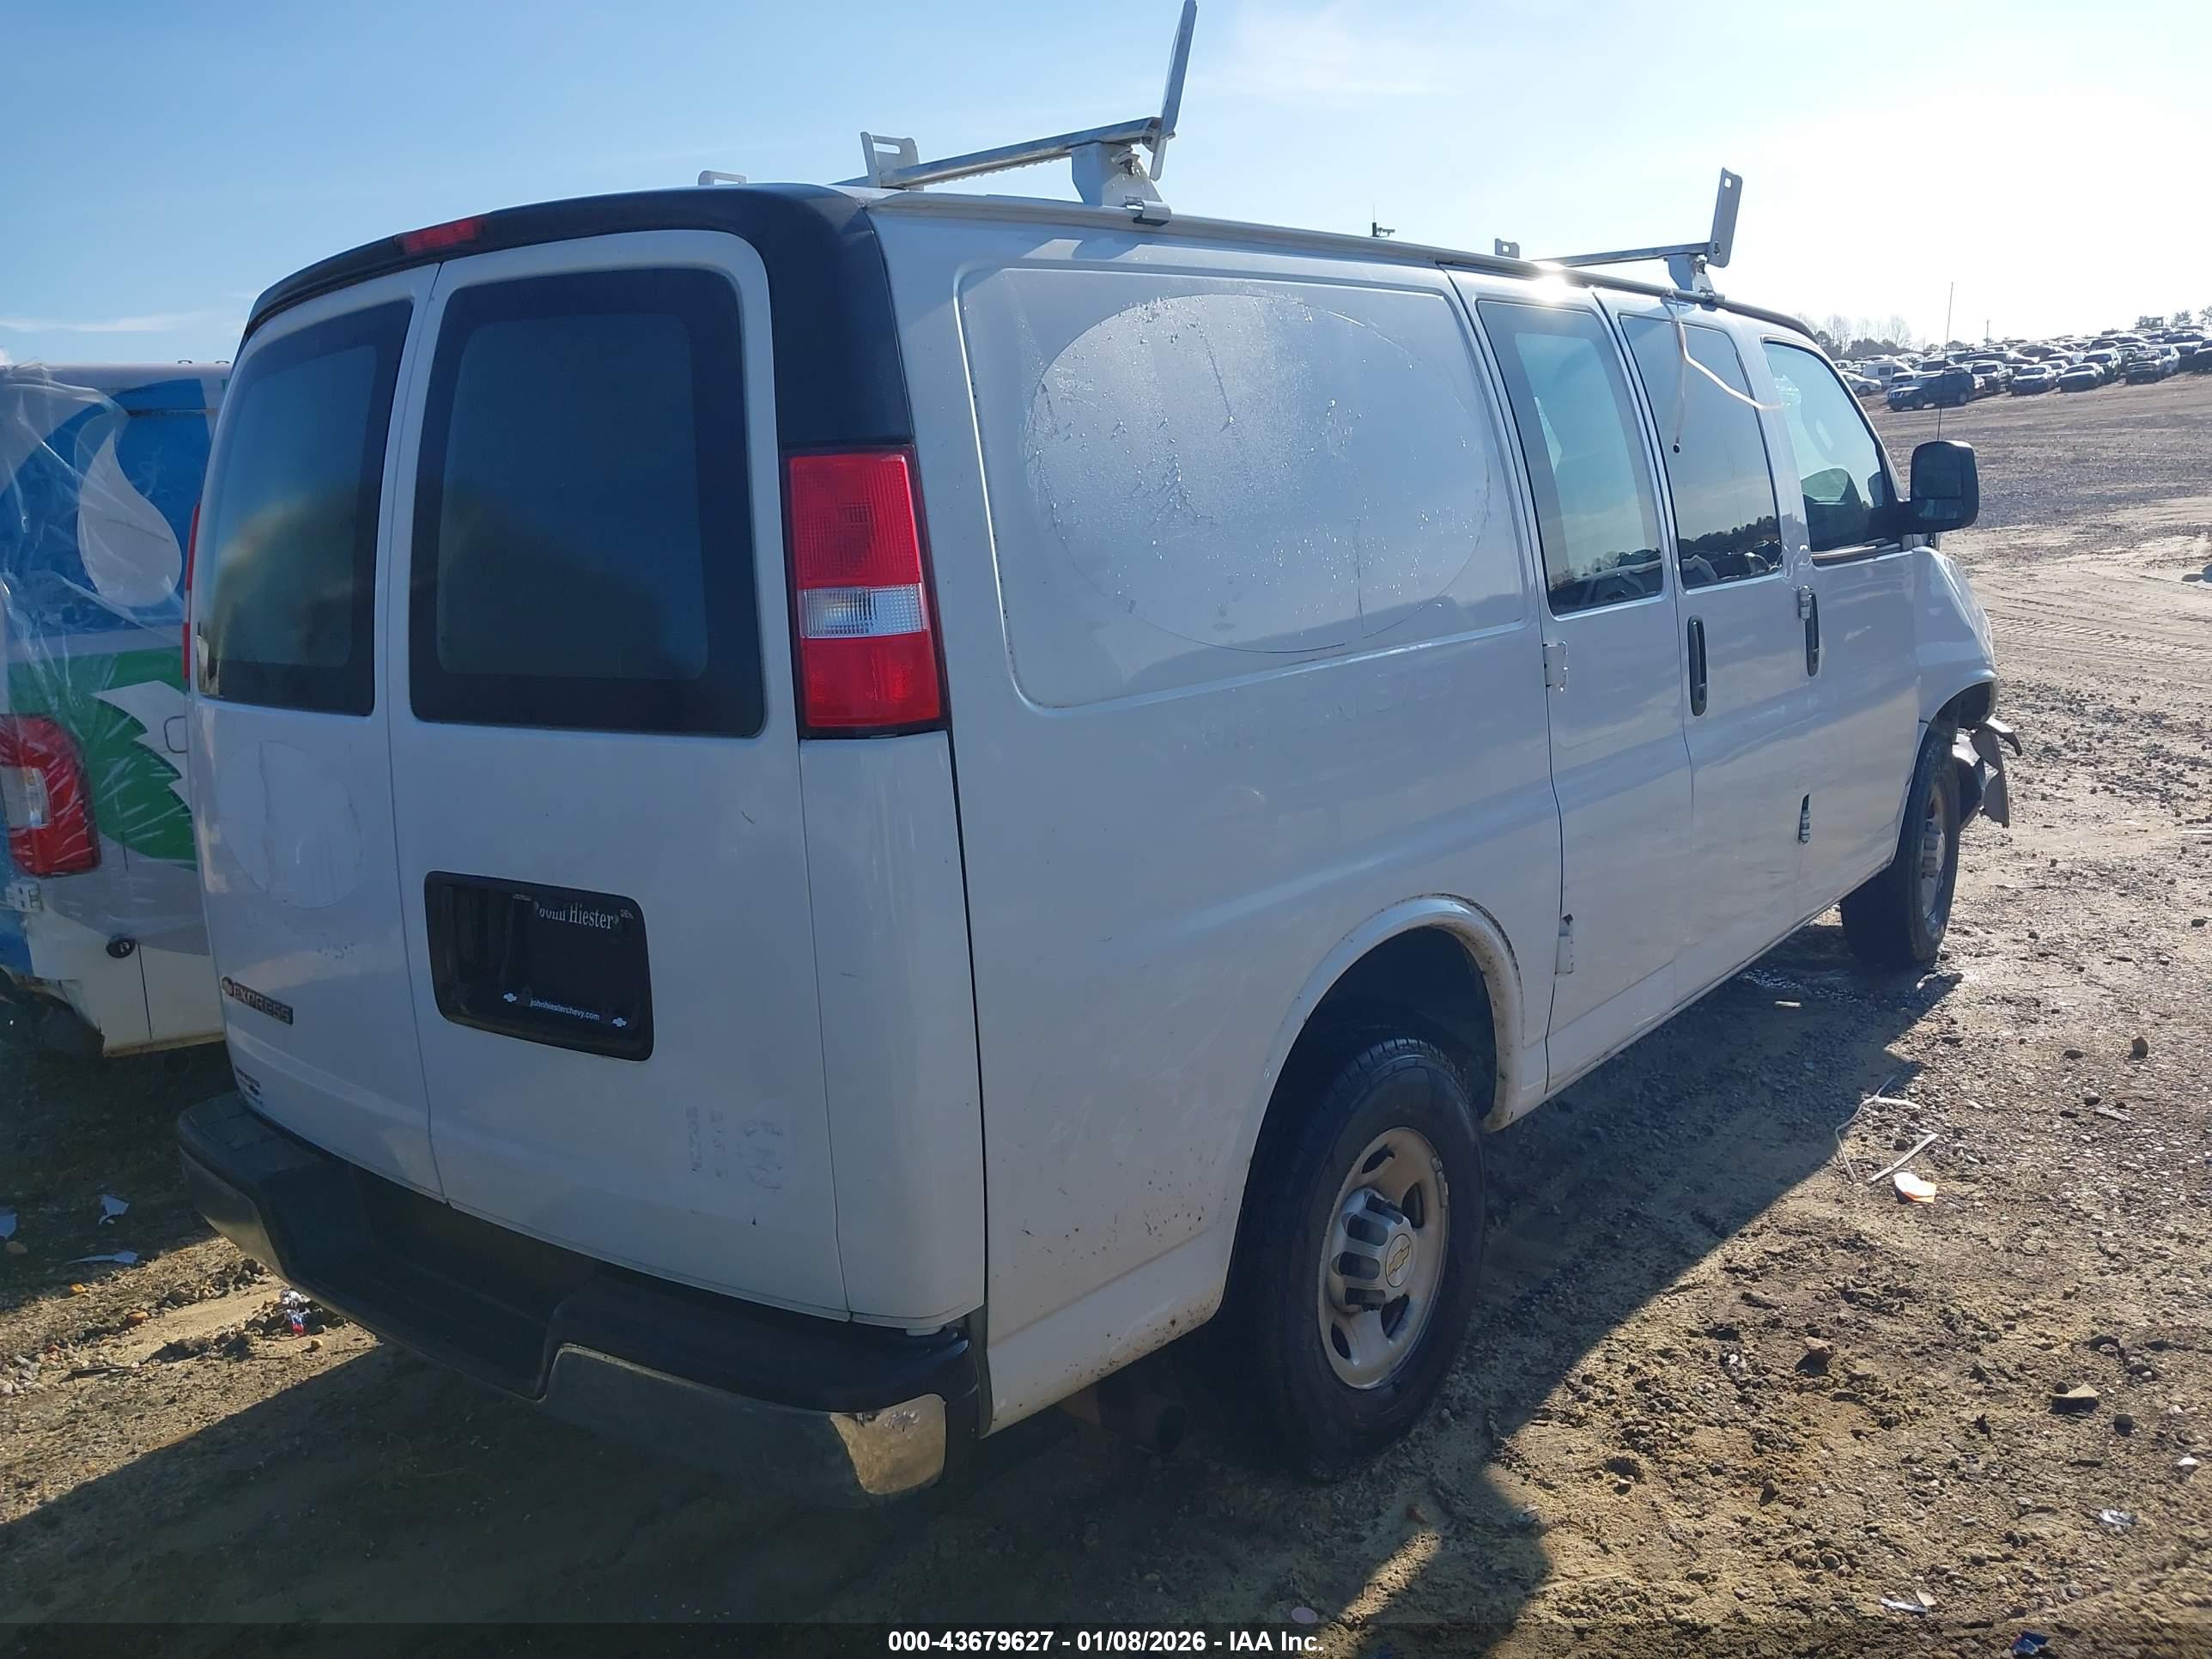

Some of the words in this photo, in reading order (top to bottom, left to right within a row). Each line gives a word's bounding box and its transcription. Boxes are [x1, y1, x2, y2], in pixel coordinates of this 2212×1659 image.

[568, 902, 614, 929] Hiester
[233, 985, 291, 1021] EXPRESS
[529, 997, 600, 1021] johnhiesterchevy.com
